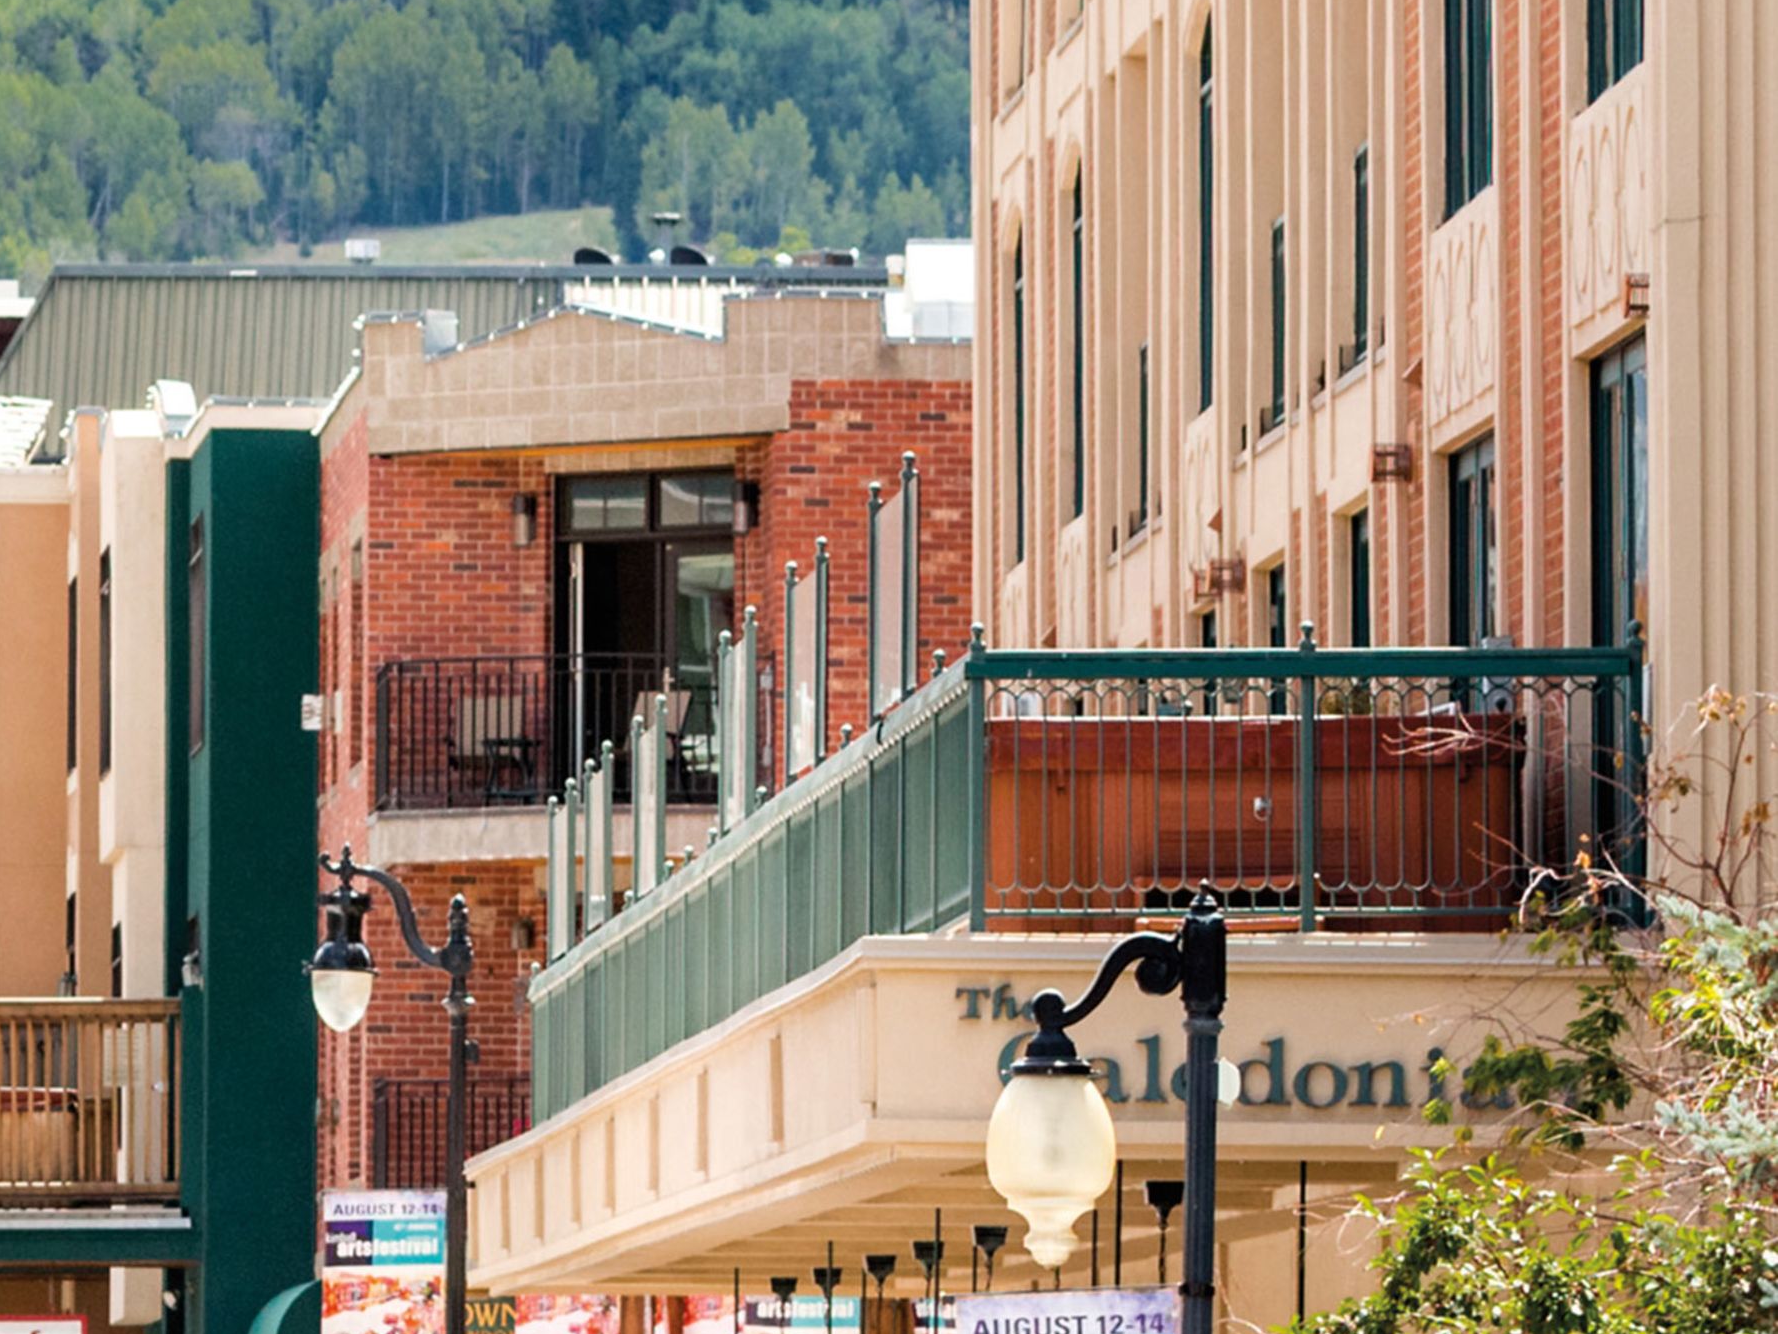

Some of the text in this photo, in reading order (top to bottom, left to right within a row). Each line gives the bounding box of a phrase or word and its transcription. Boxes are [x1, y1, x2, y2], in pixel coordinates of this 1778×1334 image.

[334, 1204, 438, 1216] AUGUST 12-14
[337, 1237, 438, 1257] artsfestival
